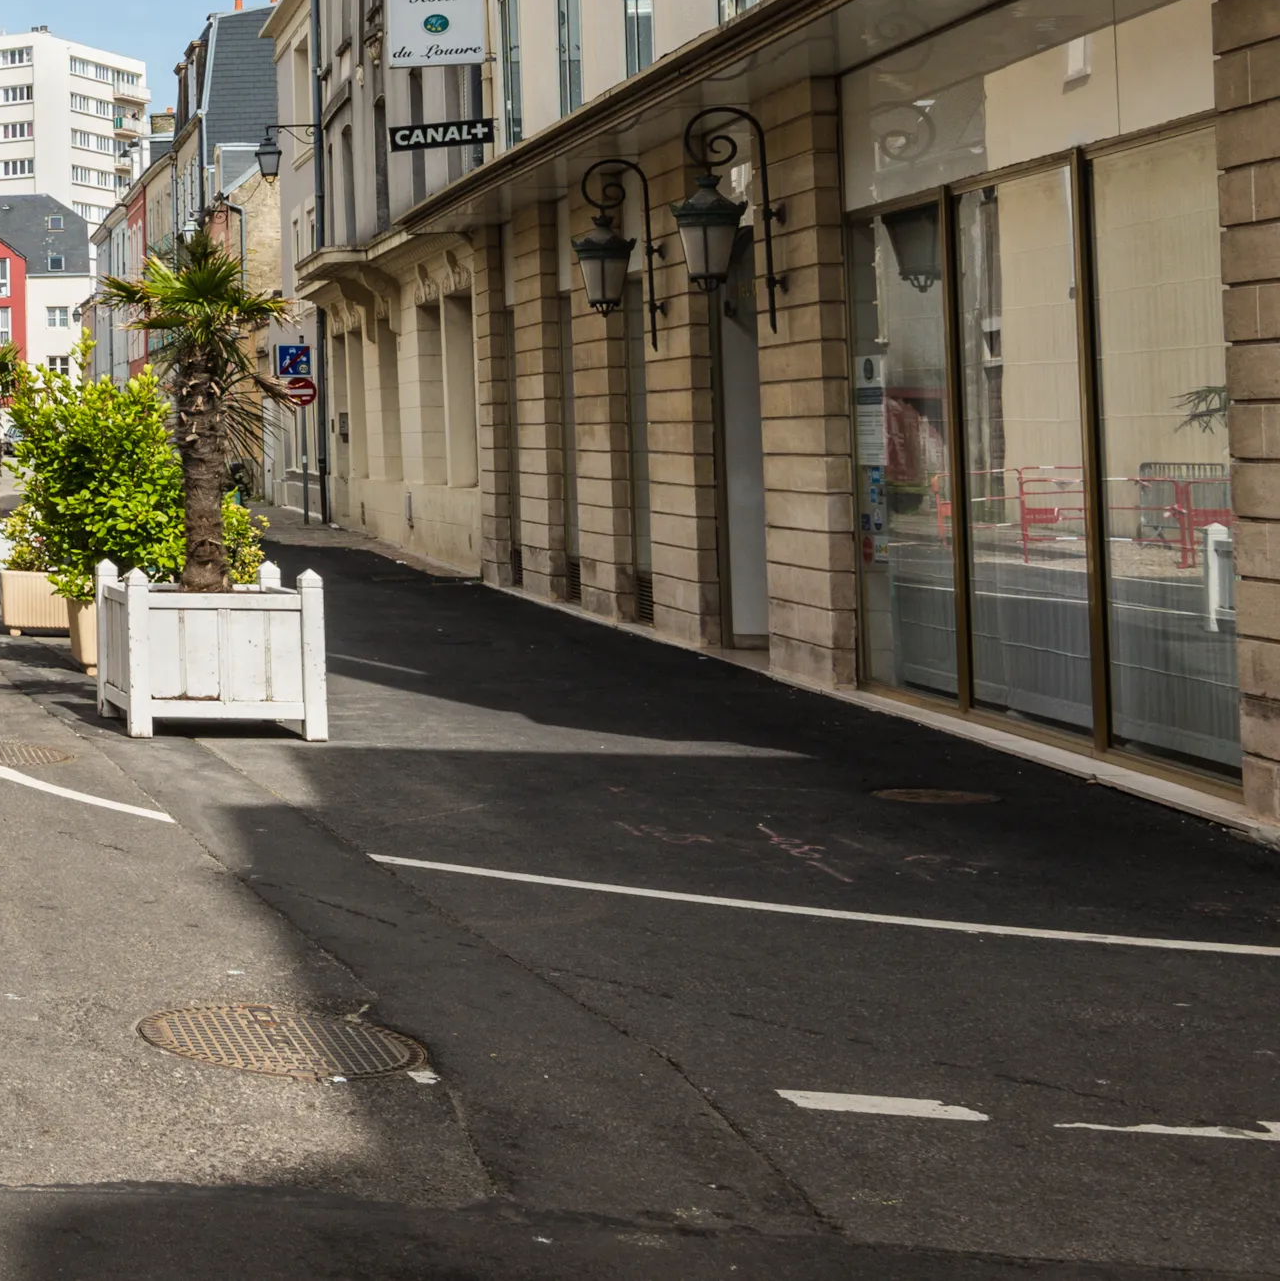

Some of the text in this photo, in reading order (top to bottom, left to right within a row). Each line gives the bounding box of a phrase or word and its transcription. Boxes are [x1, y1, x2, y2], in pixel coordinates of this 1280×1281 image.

[392, 44, 483, 59] du Louvre
[394, 123, 489, 146] CANAL+
